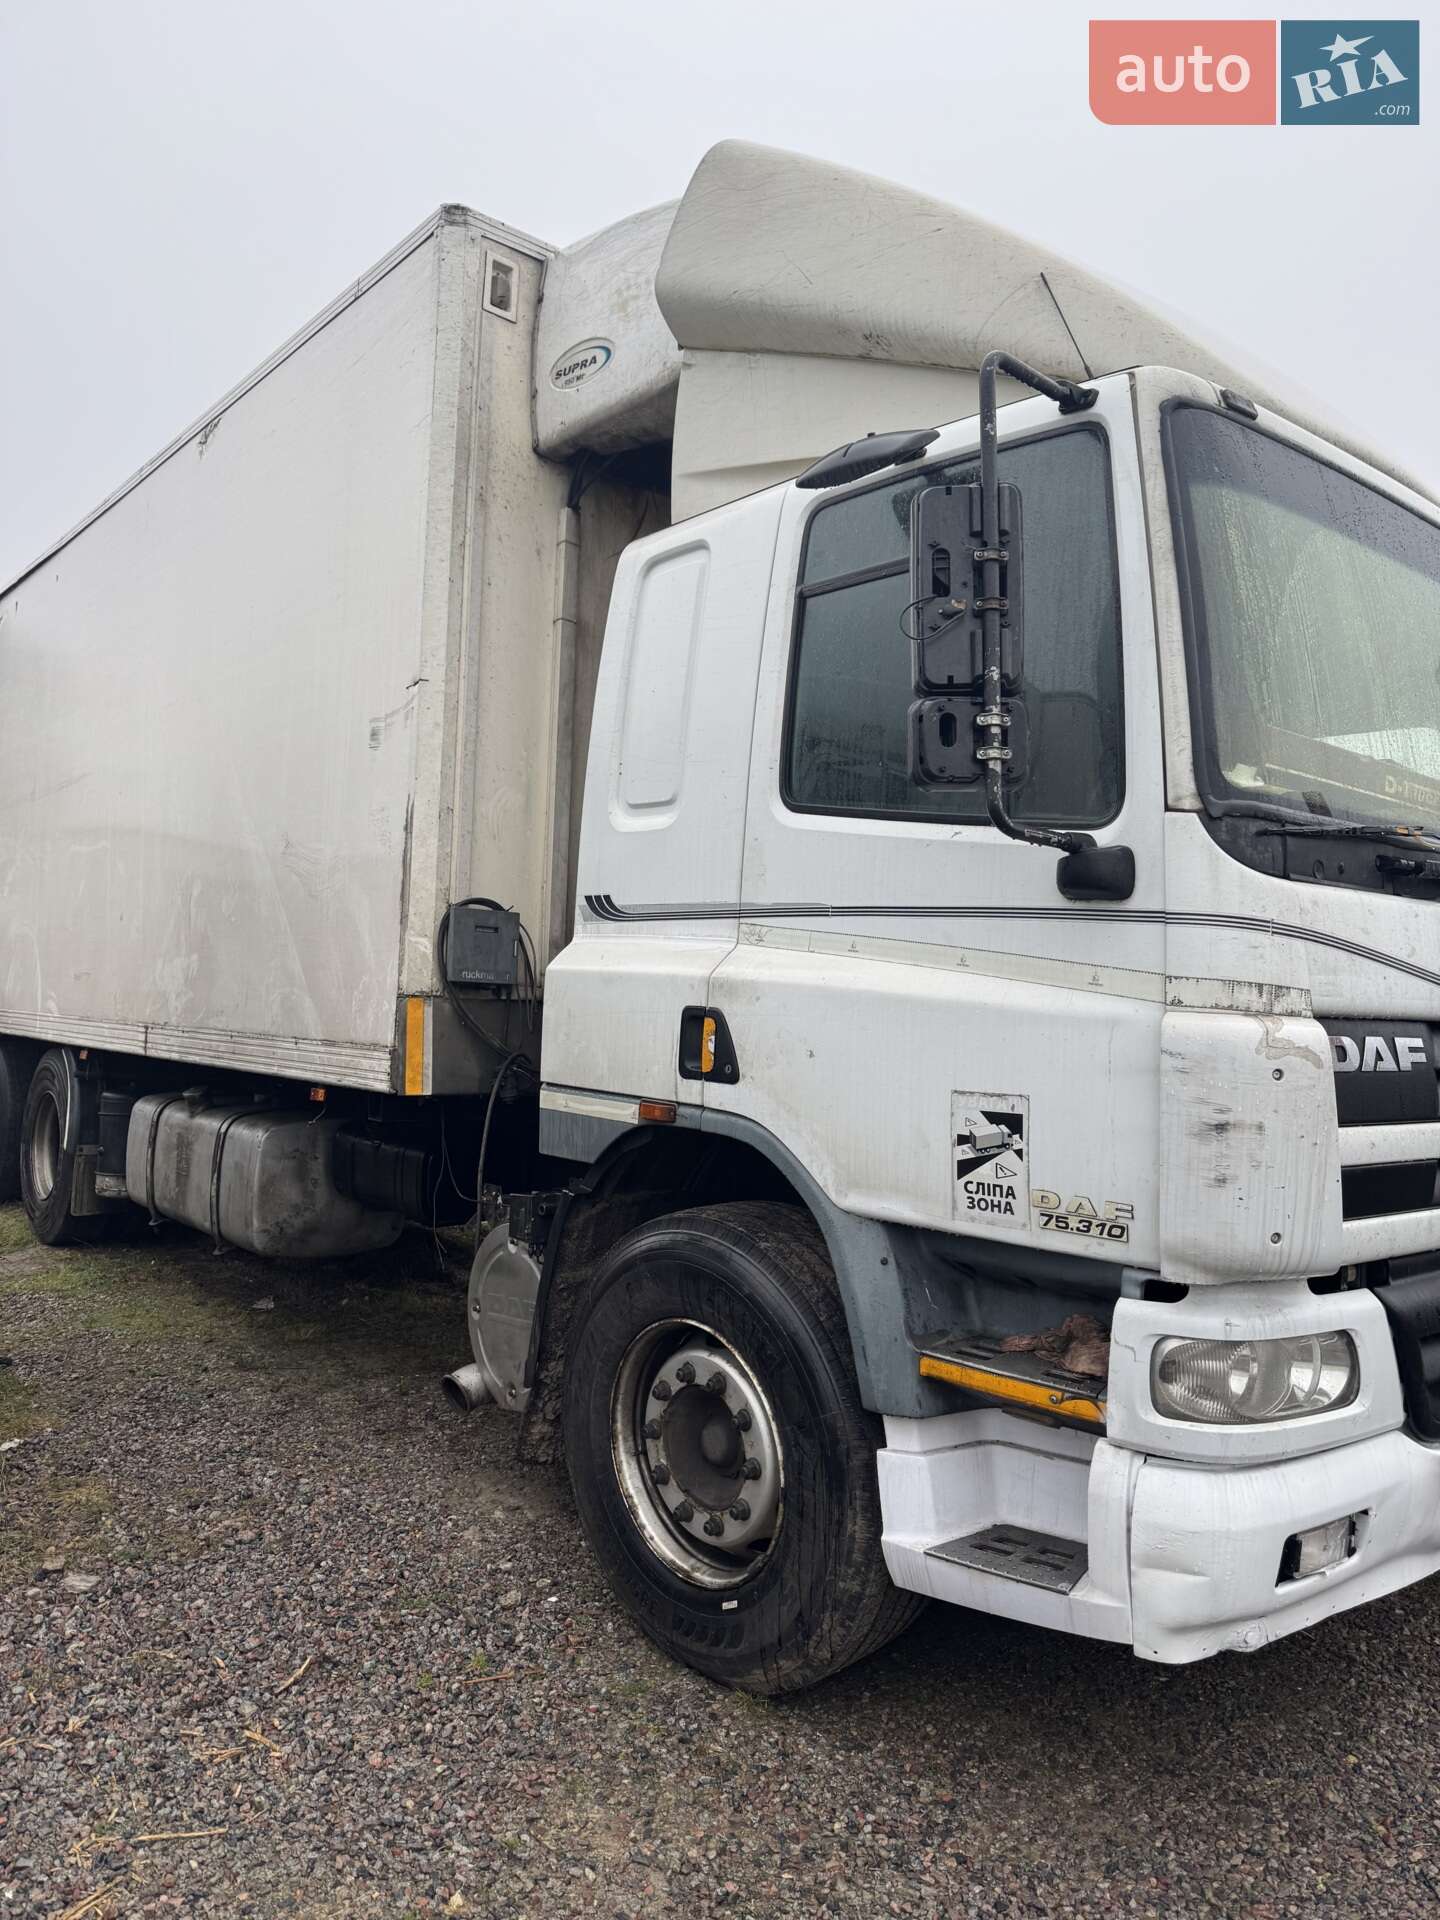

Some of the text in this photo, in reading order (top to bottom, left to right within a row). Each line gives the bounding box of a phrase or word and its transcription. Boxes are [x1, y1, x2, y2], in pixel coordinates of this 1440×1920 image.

[554, 355, 597, 380] SUPRA
[1328, 1035, 1427, 1072] DAF
[963, 1180, 1017, 1200] СЛІПА
[966, 1196, 1015, 1216] ЗОНА
[1032, 1189, 1135, 1223] DAF
[1039, 1212, 1127, 1240] 75.310
